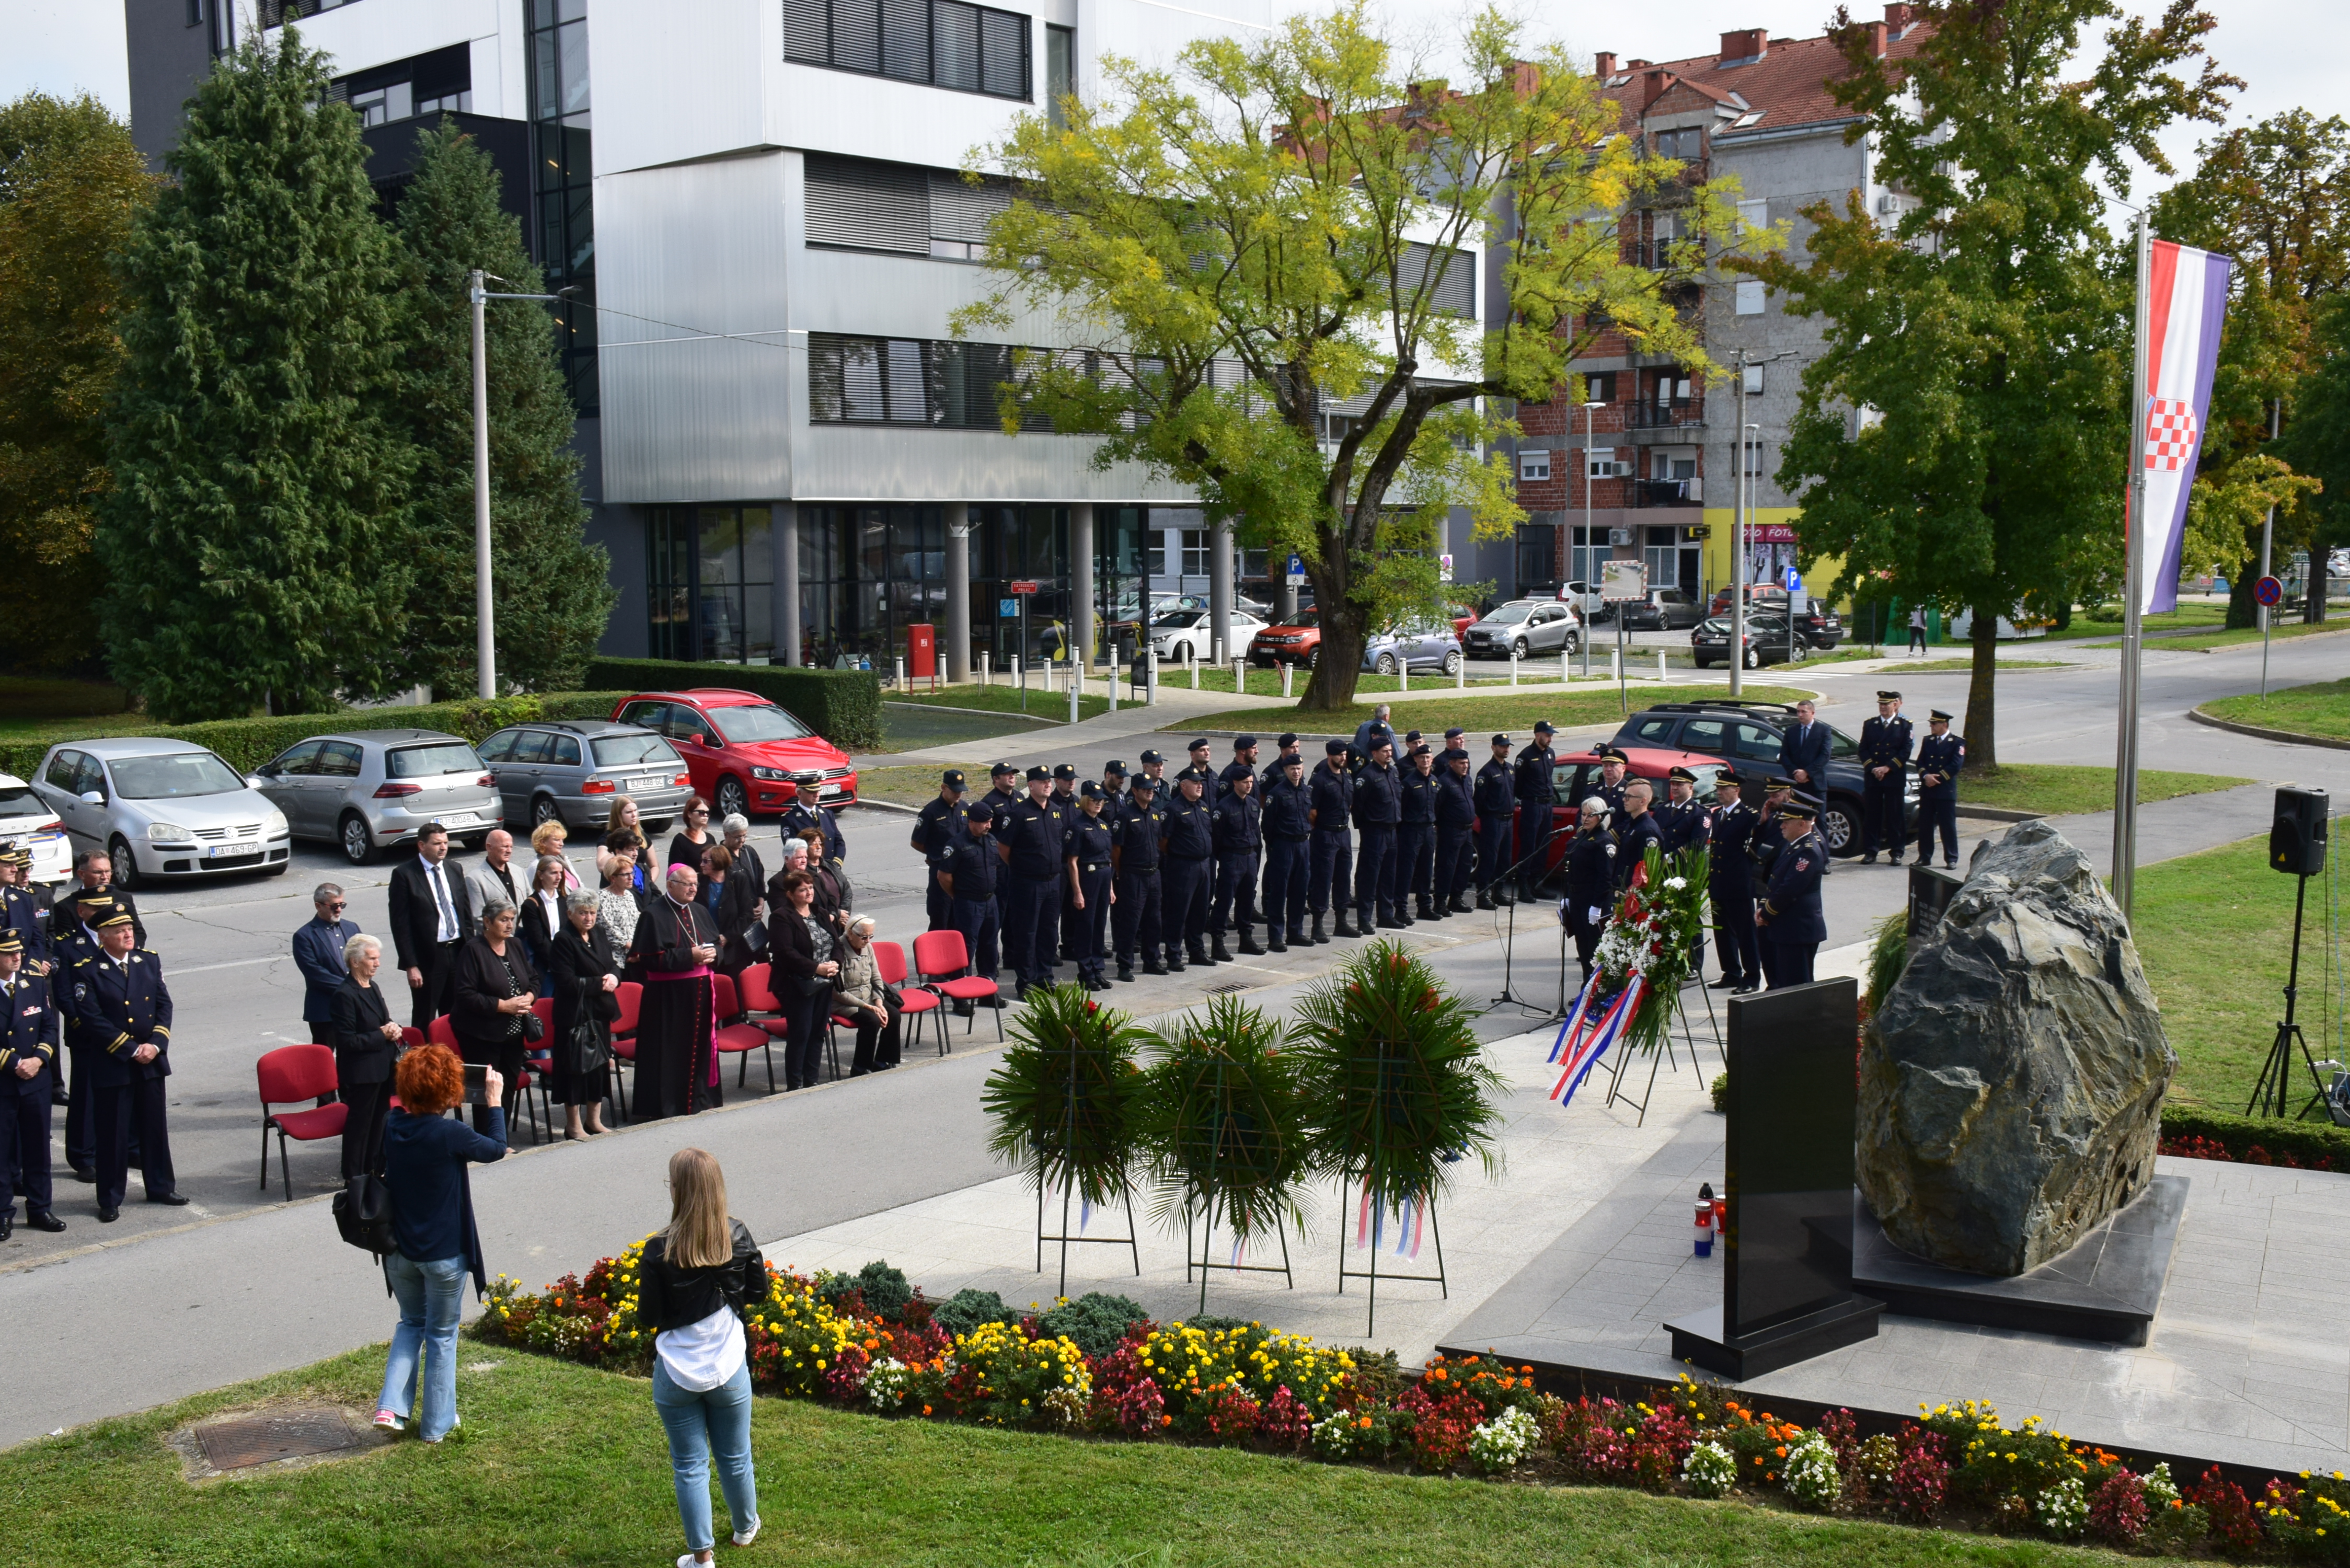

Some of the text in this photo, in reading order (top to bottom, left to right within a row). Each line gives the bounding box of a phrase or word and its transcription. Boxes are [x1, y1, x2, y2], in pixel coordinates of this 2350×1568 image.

[1292, 558, 1299, 571] P
[1790, 571, 1797, 586] P
[231, 844, 256, 854] 469-GP
